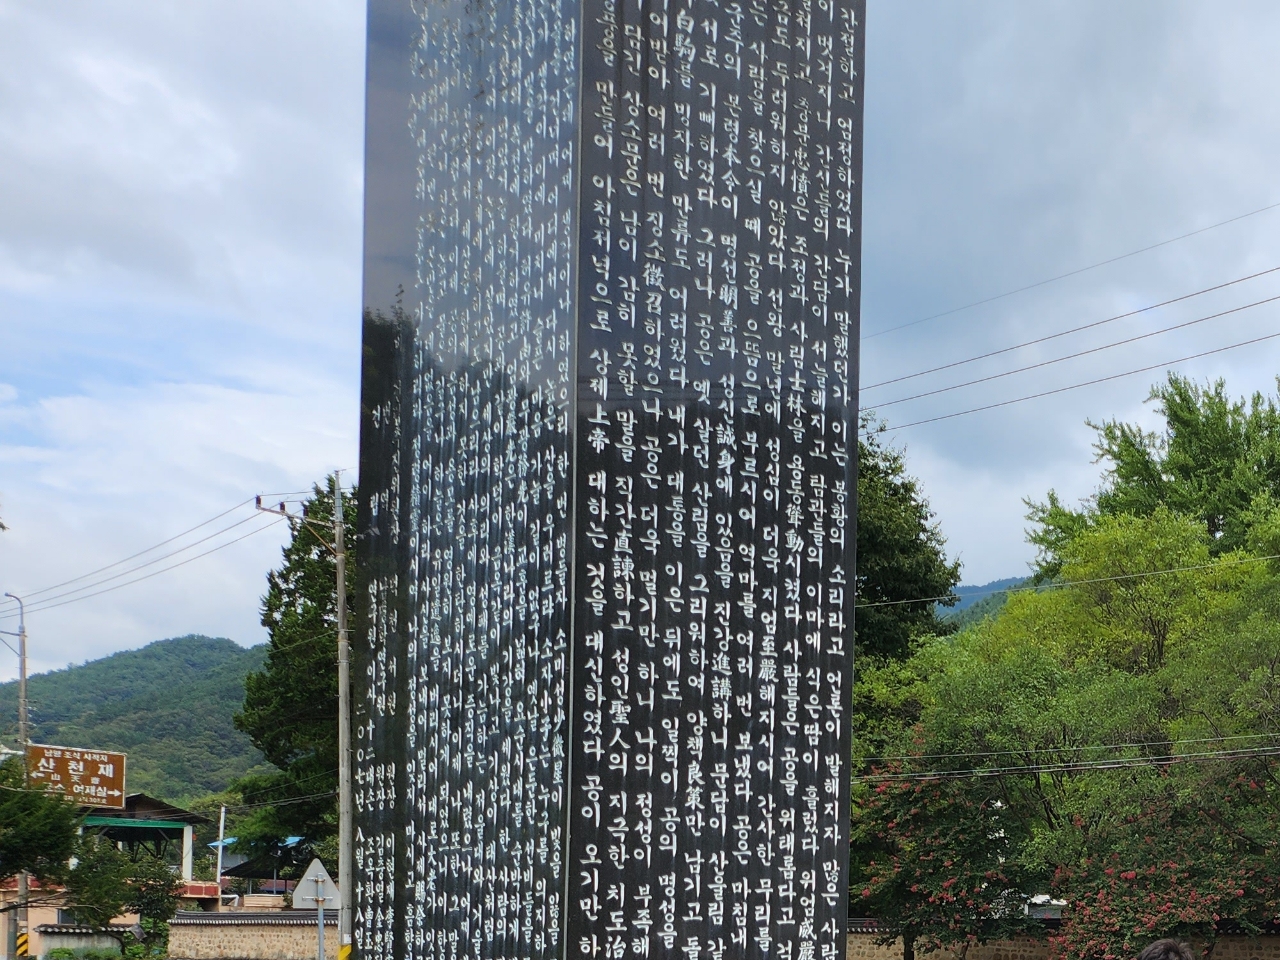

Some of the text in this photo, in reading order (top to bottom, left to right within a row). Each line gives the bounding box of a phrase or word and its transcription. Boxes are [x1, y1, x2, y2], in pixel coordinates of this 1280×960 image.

[624, 25, 644, 76] 담긴
[701, 19, 719, 68] 서로
[748, 41, 768, 116] 사람을
[594, 80, 617, 159] 만들어
[620, 91, 644, 196] 상소문은
[648, 105, 665, 156] 여러
[673, 103, 694, 180] 빙자한
[697, 83, 718, 209] 기뻐하였다
[770, 62, 789, 187] 두려워하지
[647, 172, 664, 198] 번
[746, 128, 766, 204] 찾으실
[813, 145, 833, 241] 간신들의
[836, 118, 854, 237] 엄정하였다
[590, 174, 615, 332] 아침저녁으로
[619, 210, 641, 262] 남이
[671, 193, 692, 270] 만류도
[695, 228, 716, 296] 그러나
[745, 217, 760, 241] 때
[768, 199, 787, 273] 않았다
[617, 276, 640, 328] 감히
[744, 253, 763, 305] 공을
[789, 236, 809, 306] 조정과
[812, 255, 831, 326] 간담이
[835, 249, 852, 297] 누가
[642, 211, 666, 422] 징소徵召하였으나
[669, 287, 689, 389] 어려웠다
[694, 313, 714, 365] 공은
[766, 288, 786, 337] 선왕
[617, 342, 638, 396] 못할
[693, 379, 710, 405] 옛
[741, 319, 761, 416] 으뜸으로
[765, 351, 785, 424] 말년에
[787, 321, 808, 443] 사림士林을
[833, 311, 852, 407] 말했던가
[588, 349, 612, 454] 상제上帝
[615, 409, 638, 462] 말을
[668, 404, 689, 455] 내가
[716, 373, 737, 498] 성신誠身에
[809, 341, 828, 459] 서늘해지고
[640, 436, 662, 489] 공은
[693, 417, 713, 468] 살던
[763, 437, 780, 511] 성심이
[831, 420, 849, 468] 이는
[586, 470, 609, 548] 대하는
[665, 470, 686, 547] 대통을
[739, 431, 759, 530] 부르시어
[829, 480, 848, 552] 봉황의
[611, 476, 637, 631] 직간直諫하고
[639, 504, 661, 556] 더욱
[690, 482, 712, 558] 산림을
[714, 513, 734, 588] 있음을
[762, 524, 780, 574] 더욱
[807, 474, 827, 570] 탐관들의
[585, 563, 607, 616] 것을
[639, 569, 660, 647] 멀기만
[664, 561, 684, 612] 이은
[737, 543, 758, 618] 역마를
[826, 565, 846, 656] 소리라고
[688, 574, 709, 696] 그리워하여
[737, 630, 753, 679] 여러
[805, 583, 825, 654] 이마에
[583, 630, 606, 761] 대신하였다
[636, 661, 659, 712] 하니
[662, 626, 684, 701] 뒤에도
[711, 601, 733, 750] 진강進講하니
[757, 586, 779, 781] 지엄至嚴해지시어
[781, 639, 802, 735] 사람들은
[539, 637, 553, 768] 소자小子는
[551, 628, 566, 811] 소미성少微星이
[609, 647, 631, 777] 성인聖人의
[736, 692, 752, 717] 번
[826, 671, 843, 740] 언론이
[63, 751, 81, 760] 조식
[376, 764, 386, 810] 원장
[386, 762, 396, 809] 원장
[635, 727, 657, 777] 나의
[661, 717, 679, 792] 일찍이
[685, 710, 707, 837] 양책良策만
[734, 732, 753, 803] 보냈다
[779, 747, 799, 796] 공을
[509, 701, 526, 942] 요순시대를 순박하게
[536, 784, 550, 863] 누구를
[581, 775, 603, 828] 공이
[607, 791, 630, 870] 지극한
[634, 792, 652, 868] 정성이
[659, 807, 680, 859] 공의
[710, 763, 729, 838] 문답이
[756, 793, 776, 866] 간사한
[802, 785, 819, 858] 흘렀다
[824, 753, 842, 847] 발해지자
[356, 826, 365, 870] 八월
[473, 789, 485, 888] 저울대와
[485, 751, 499, 942] 기상이 태산처럼
[496, 736, 511, 941] 세웠다 한 사람의
[521, 746, 538, 943] 은둔한 선비들을
[550, 826, 562, 879] 빛을
[732, 815, 752, 865] 공은
[776, 808, 796, 925] 위태롭다고
[355, 882, 365, 950] 十八일
[546, 892, 560, 946] 잃을
[580, 844, 602, 921] 오기만
[657, 872, 677, 950] 명성을
[682, 849, 705, 922] 남기고
[731, 877, 751, 950] 마침내
[754, 879, 773, 952] 무리를
[821, 859, 840, 906] 많은
